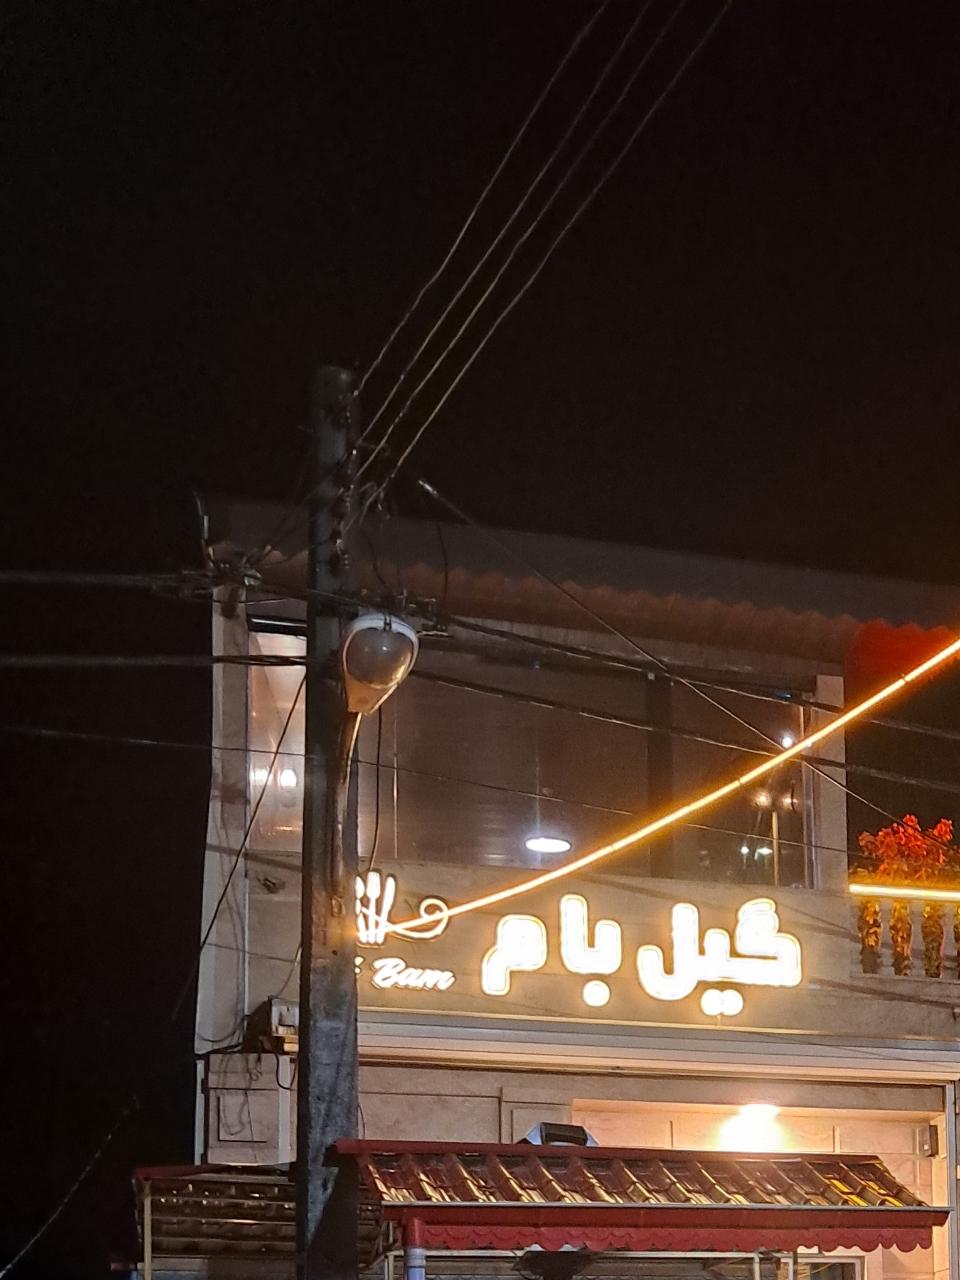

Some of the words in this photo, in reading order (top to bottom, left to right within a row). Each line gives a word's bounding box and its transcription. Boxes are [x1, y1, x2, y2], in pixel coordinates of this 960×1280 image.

[371, 956, 456, 991] Bam
[481, 893, 622, 1008] بام
[637, 897, 802, 1017] گیل
